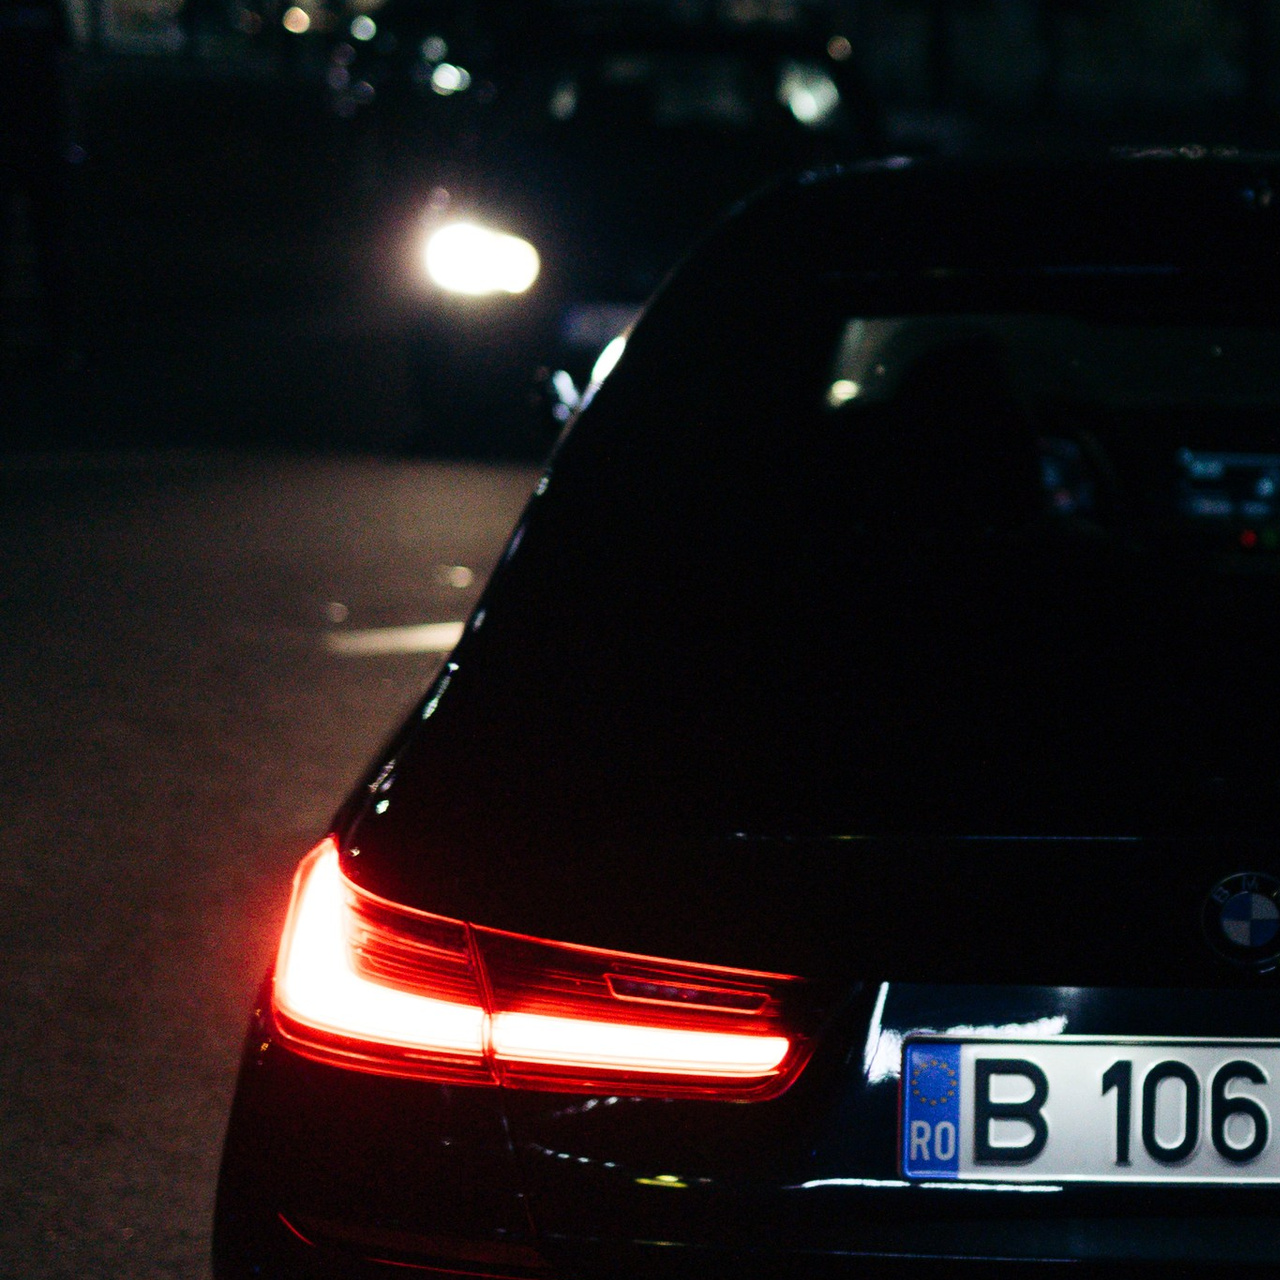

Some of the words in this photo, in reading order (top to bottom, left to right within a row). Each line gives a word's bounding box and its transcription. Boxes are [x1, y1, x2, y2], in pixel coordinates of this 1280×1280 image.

[909, 1120, 956, 1161] RO
[974, 1058, 1049, 1164] B
[1101, 1059, 1268, 1164] 106
